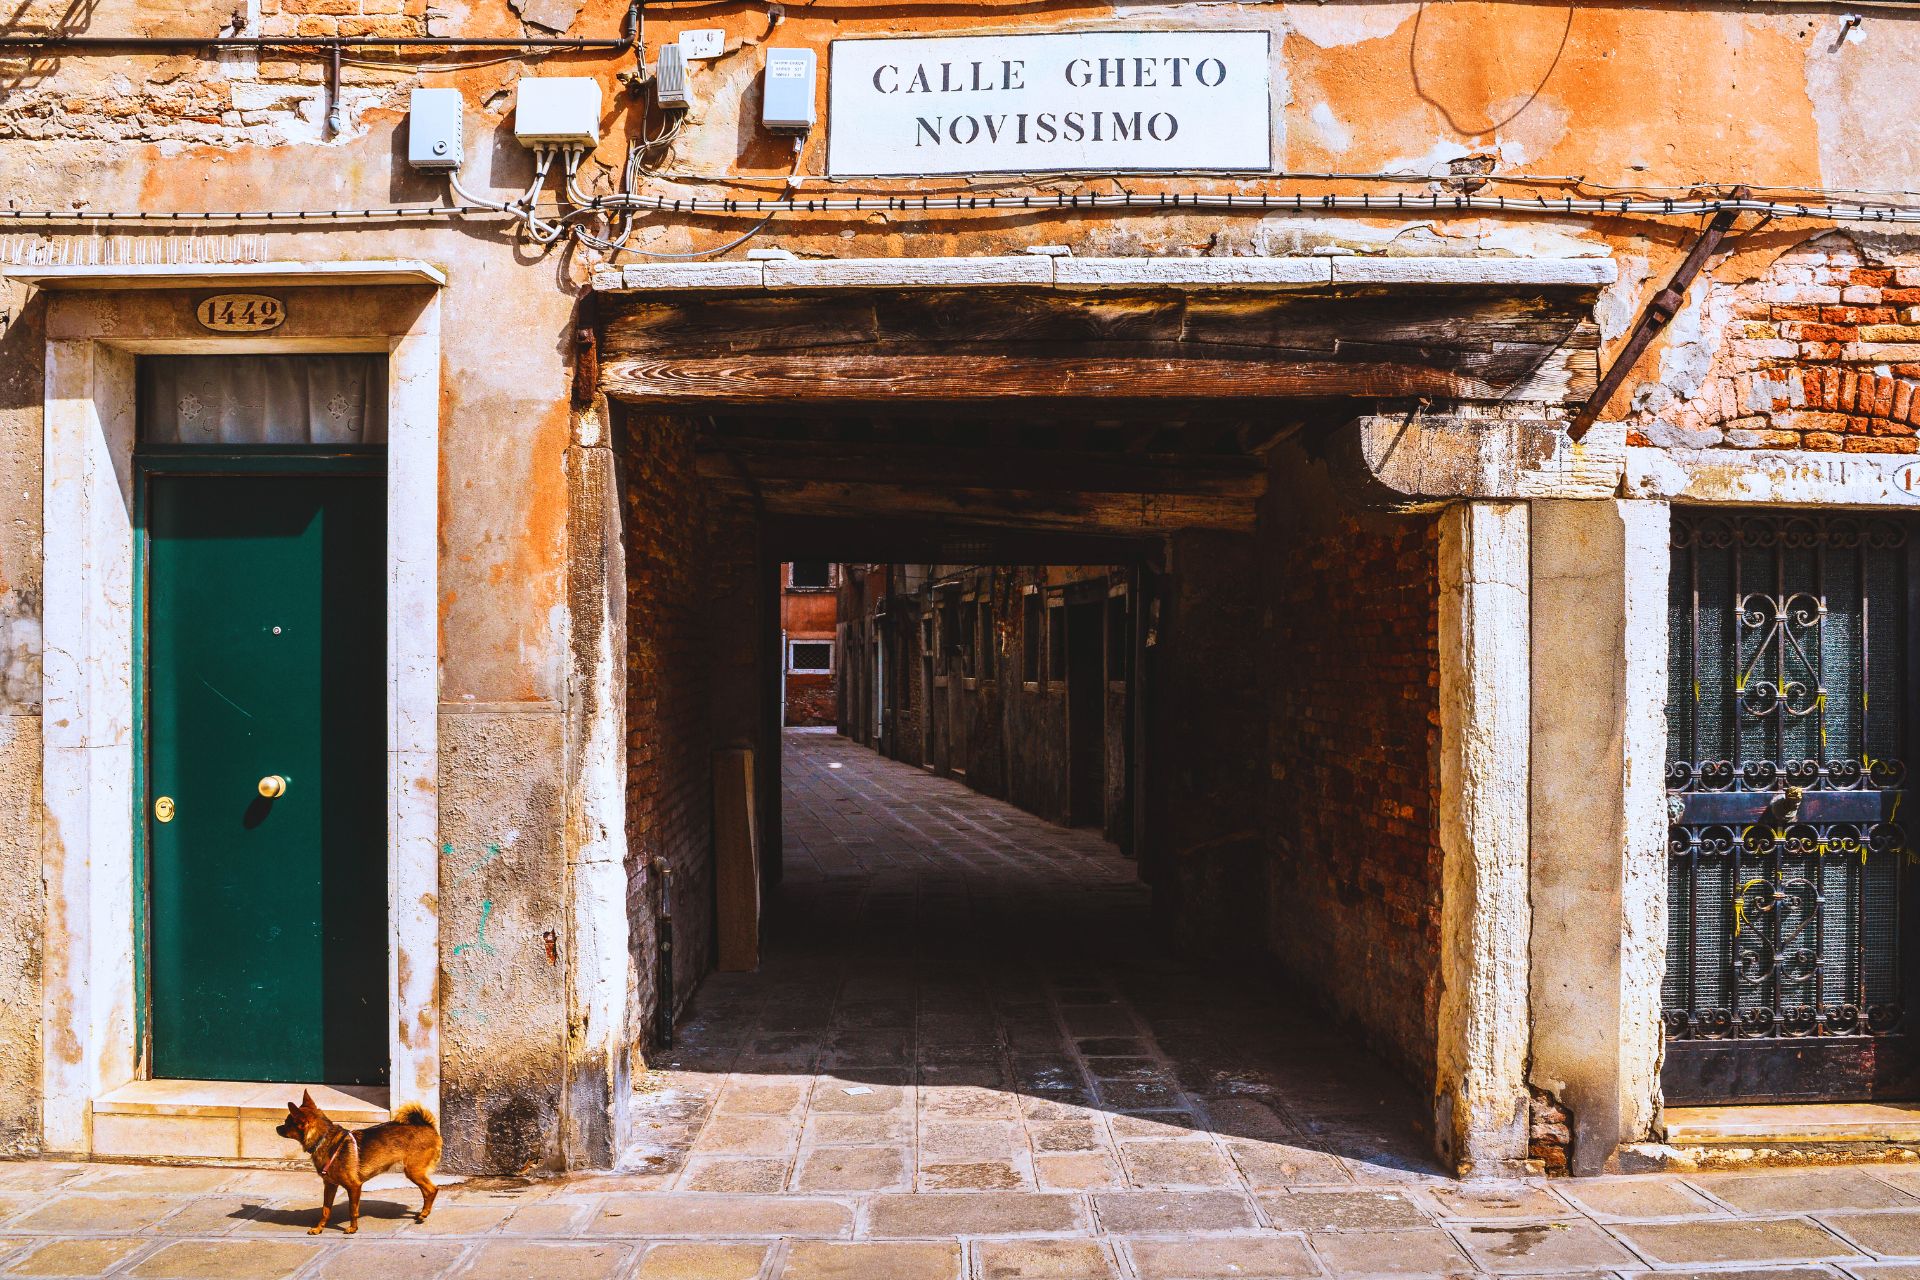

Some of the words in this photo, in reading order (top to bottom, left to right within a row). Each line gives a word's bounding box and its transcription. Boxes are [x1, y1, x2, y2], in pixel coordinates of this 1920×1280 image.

[873, 60, 1025, 94] CALLE
[1065, 57, 1227, 88] GHETO
[915, 111, 1179, 147] NOVISSIMO
[207, 301, 278, 325] 1442
